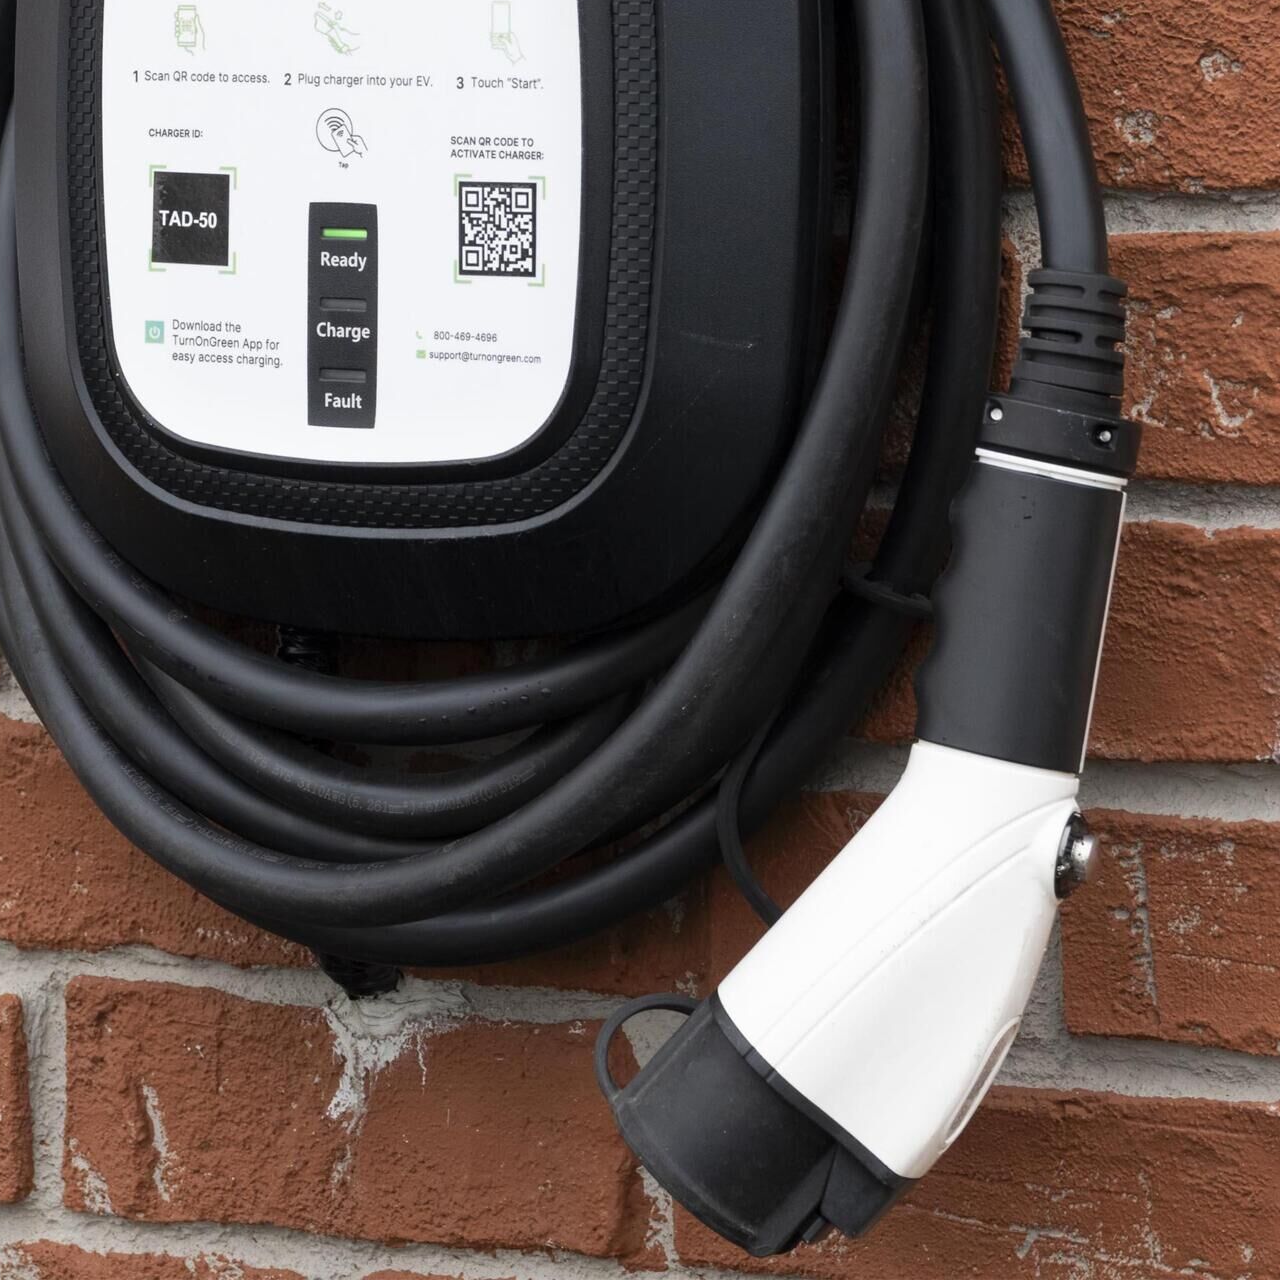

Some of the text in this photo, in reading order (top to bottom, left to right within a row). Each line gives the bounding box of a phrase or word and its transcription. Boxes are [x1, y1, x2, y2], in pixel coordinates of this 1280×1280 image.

[132, 69, 271, 84] 1 Scan QR code to access.
[283, 72, 433, 89] 2 Plug charger into your EV.
[456, 76, 465, 90] 3
[470, 76, 504, 89] Touch
[148, 127, 204, 139] CHARGER ID:
[450, 135, 535, 148] SCAN QR CODE TO
[450, 148, 545, 161] ACTIVATE CHARGER:
[158, 209, 218, 229] TAD-50
[320, 251, 367, 272] Ready
[172, 318, 242, 334] Download the
[316, 321, 371, 342] Charge
[173, 335, 281, 352] TurnOnGreen App for
[433, 330, 498, 343] 800-469-4696
[171, 352, 284, 369] easy access charging.
[428, 351, 542, 365] support@turnongreen.com
[324, 392, 363, 409] Fault
